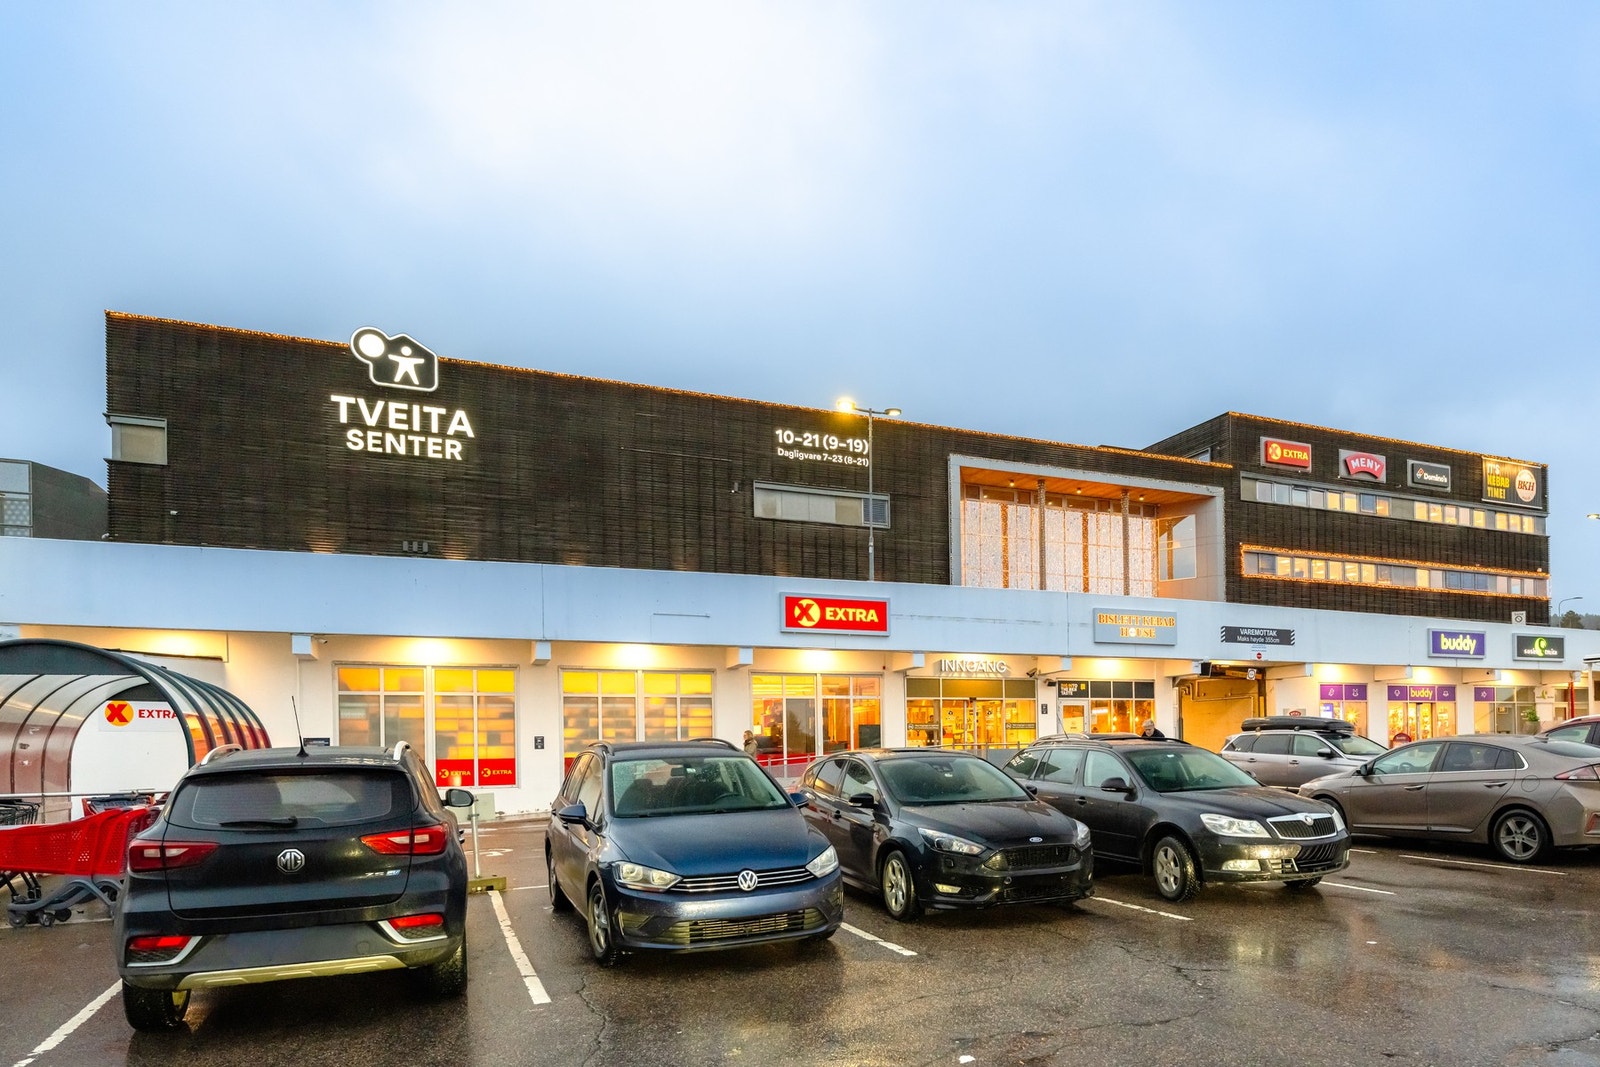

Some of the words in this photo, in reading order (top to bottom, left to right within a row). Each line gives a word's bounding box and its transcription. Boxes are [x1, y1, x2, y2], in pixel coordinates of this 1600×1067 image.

[330, 394, 475, 438] TVEITA
[346, 428, 463, 461] SENTER
[775, 429, 820, 448] 10-21
[822, 434, 869, 455] (9-19)
[777, 447, 822, 461] Dagligvare
[822, 453, 843, 464] 7-23
[1283, 449, 1309, 461] EXTRA
[1350, 457, 1381, 472] MENY
[1423, 473, 1448, 483] Domino's
[1487, 474, 1510, 489] KEBAB
[1517, 480, 1535, 492] BKH
[825, 606, 879, 623] EXTRA
[1098, 613, 1140, 625] BISLETT
[1142, 615, 1176, 627] KEBAB
[1239, 628, 1278, 637] VAREMOTTAK
[1440, 633, 1476, 655] buddy
[941, 659, 1007, 673] INNGANG
[1410, 687, 1433, 700] buddy
[280, 851, 302, 871] MG
